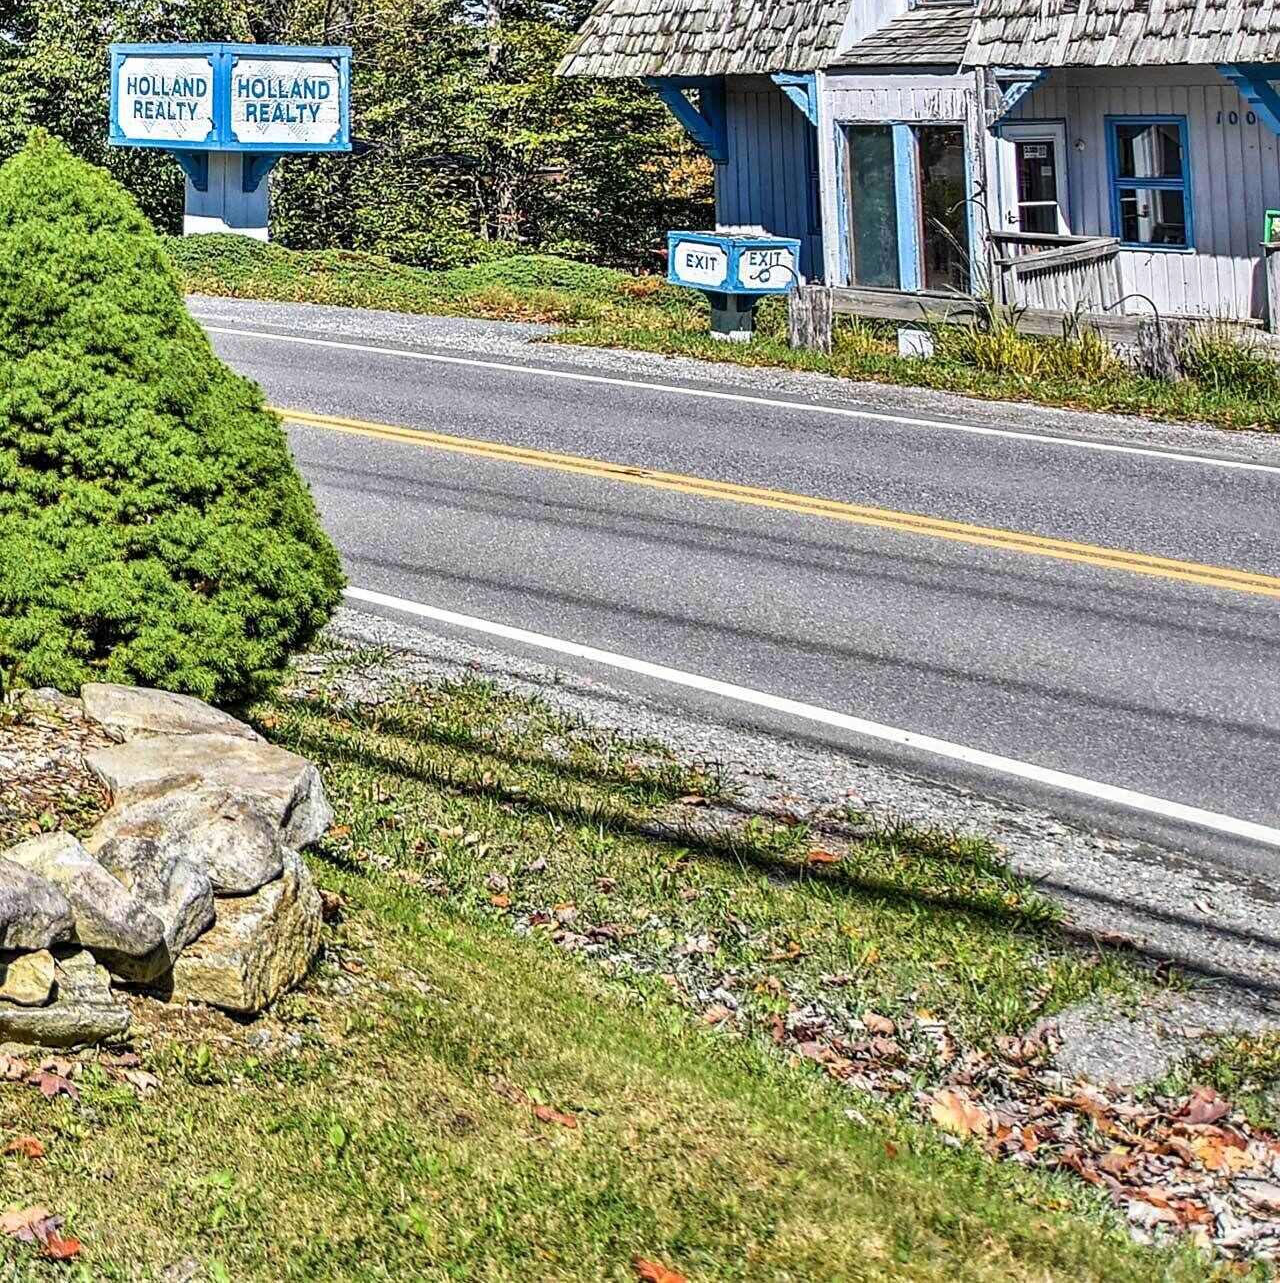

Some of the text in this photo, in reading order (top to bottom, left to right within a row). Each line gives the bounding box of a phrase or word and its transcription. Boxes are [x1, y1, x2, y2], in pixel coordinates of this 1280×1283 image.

[127, 76, 208, 98] HOLLAND
[237, 77, 331, 100] HOLLAND
[133, 99, 199, 121] REALTY
[245, 102, 322, 124] REALTY
[685, 253, 718, 271] EXIT
[748, 251, 782, 267] EXIT
